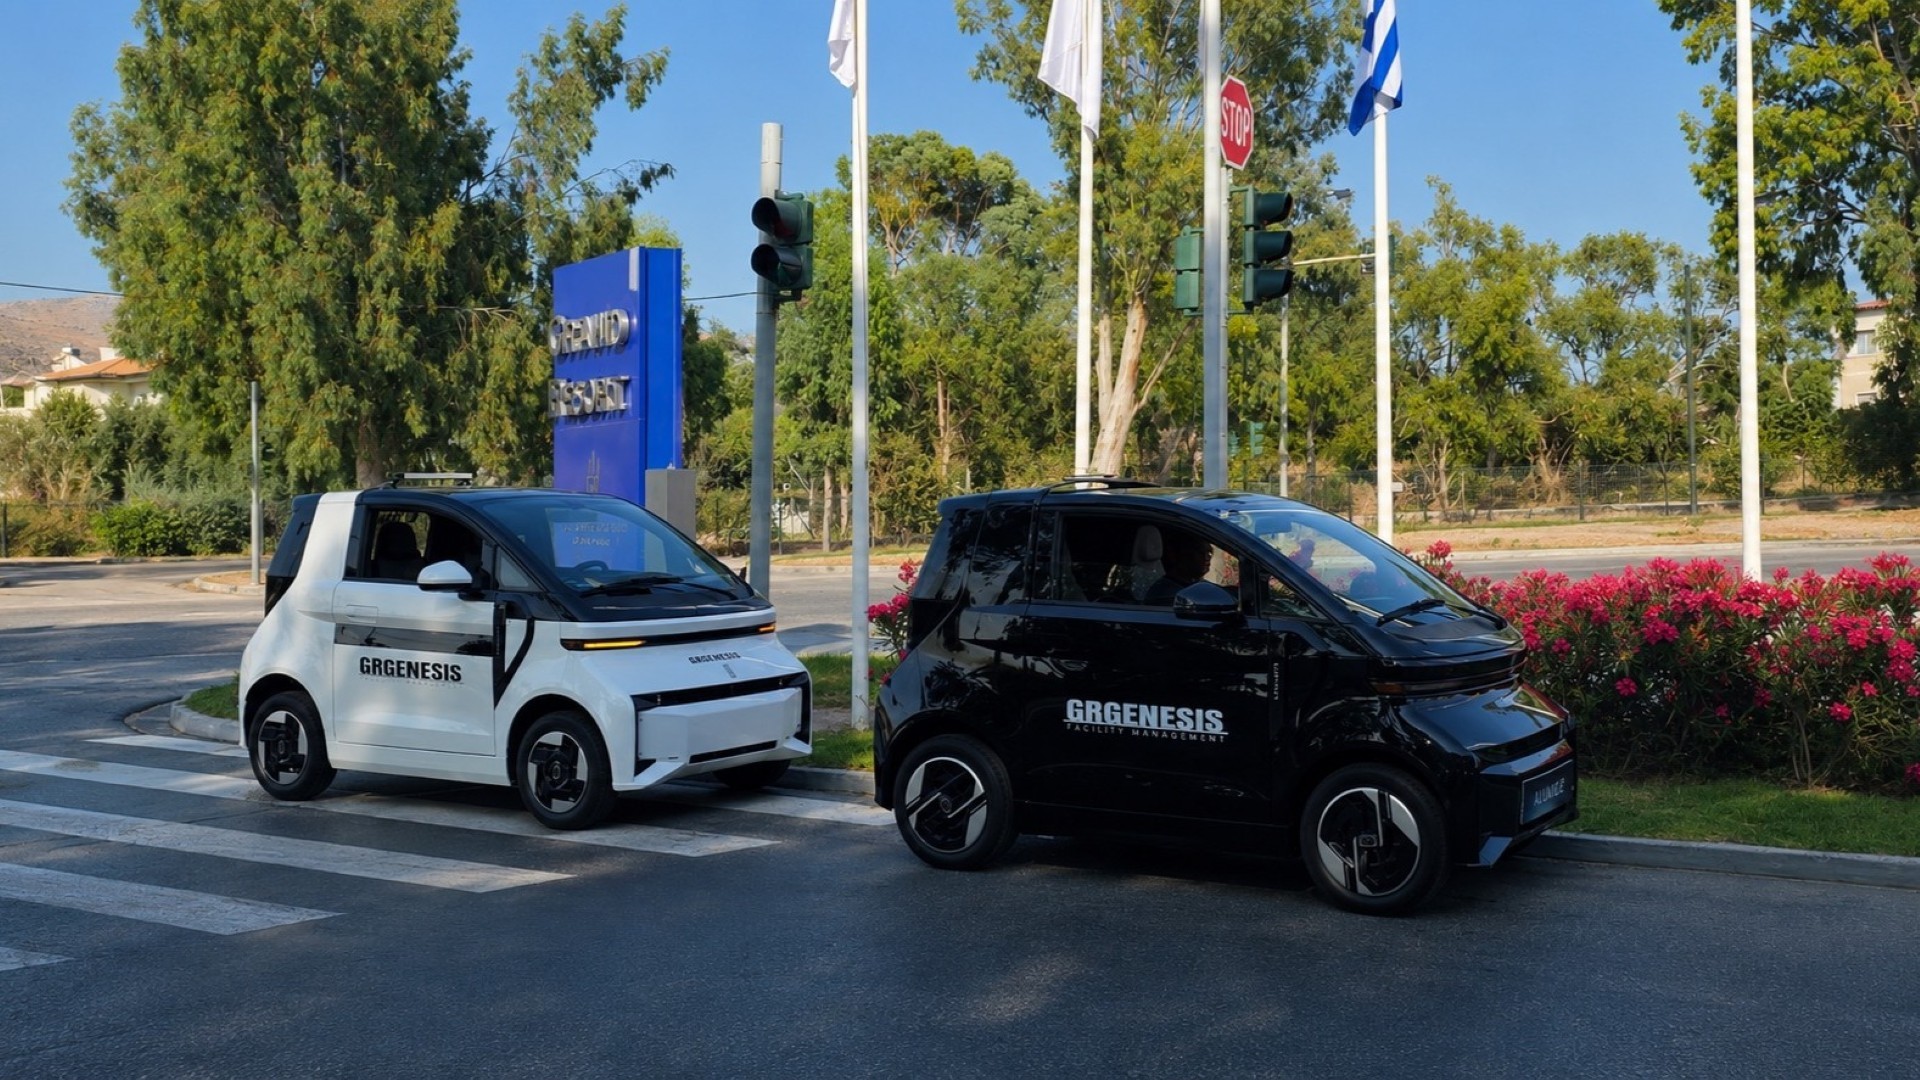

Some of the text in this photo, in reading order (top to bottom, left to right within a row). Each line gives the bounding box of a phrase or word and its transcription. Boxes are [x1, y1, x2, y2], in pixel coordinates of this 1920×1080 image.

[1221, 96, 1251, 147] STOP
[359, 656, 462, 682] GRGENESIS
[1066, 699, 1224, 733] GRGENESIS
[1066, 723, 1225, 742] FACILITY MANAGEMENT
